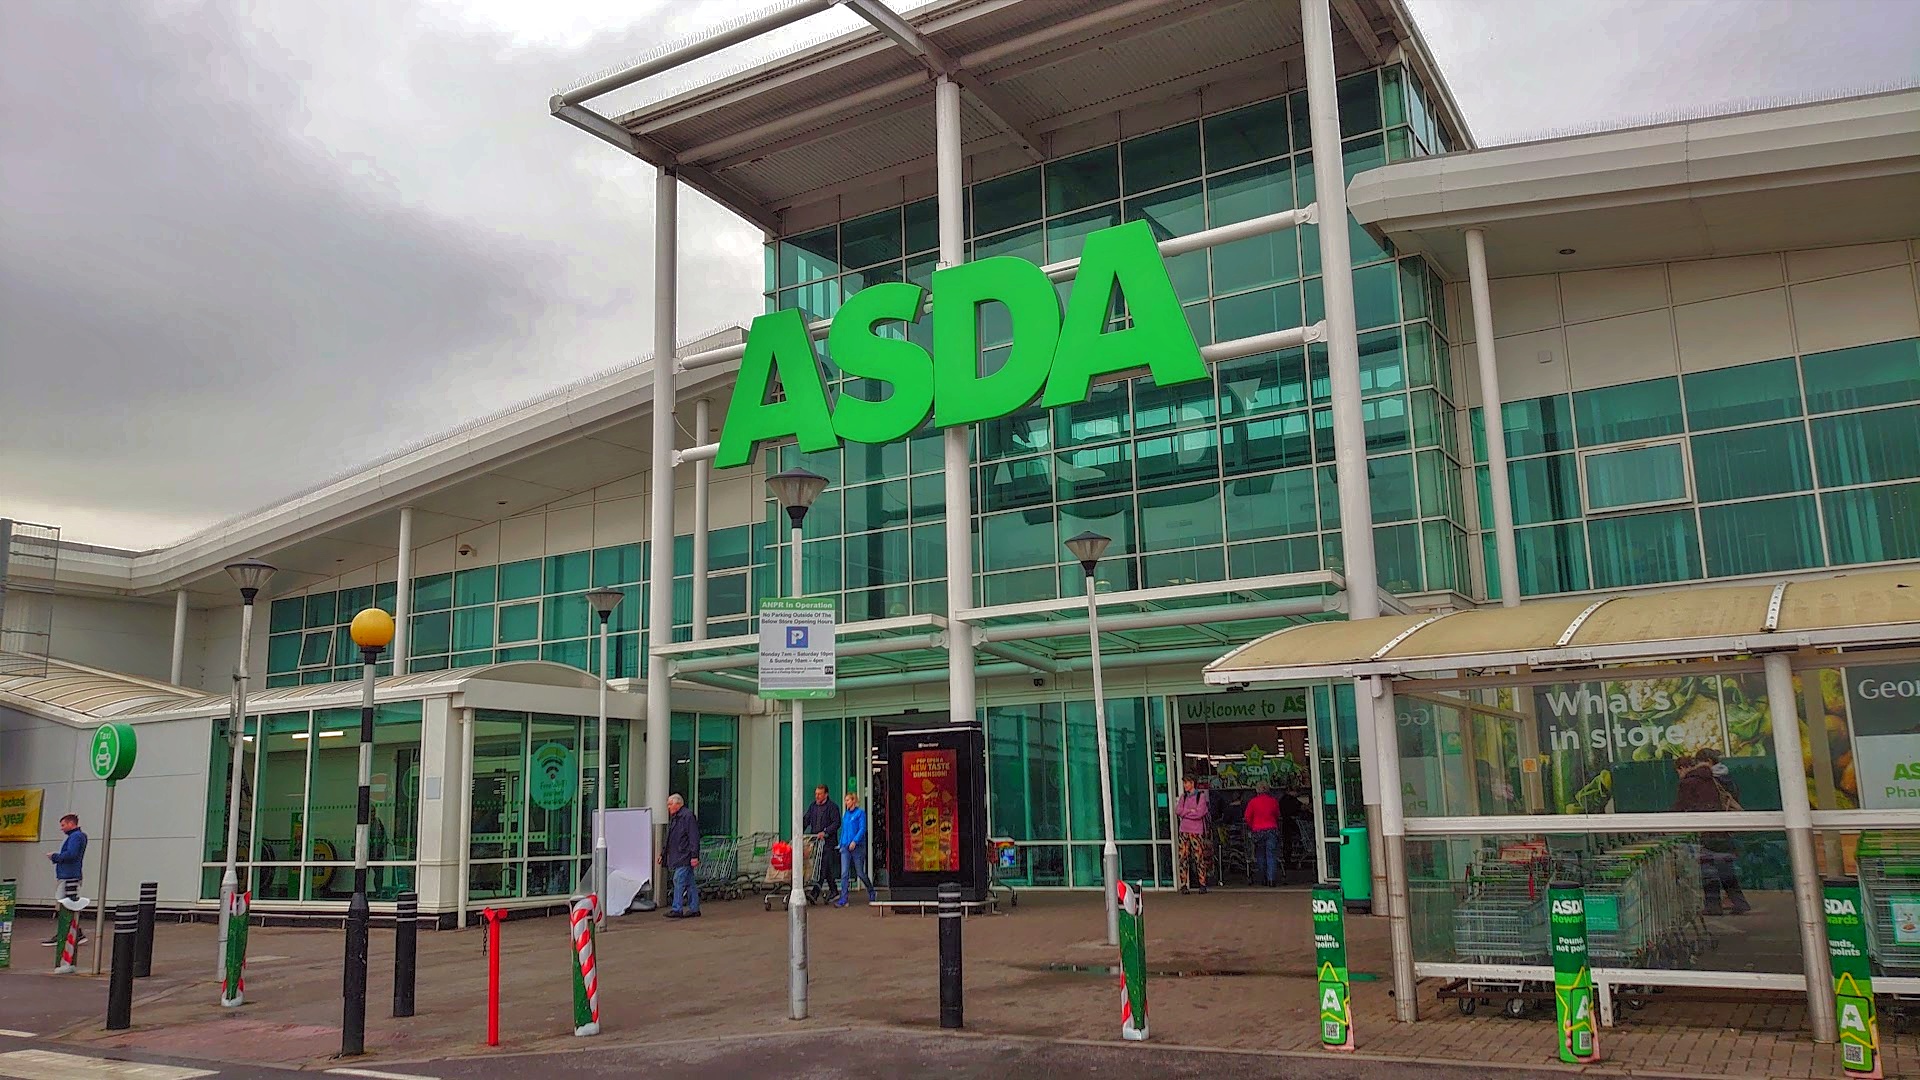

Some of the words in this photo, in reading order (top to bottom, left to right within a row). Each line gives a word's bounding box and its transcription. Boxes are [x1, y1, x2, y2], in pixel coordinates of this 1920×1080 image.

[713, 218, 1211, 469] ASDA
[791, 630, 804, 645] P
[1187, 701, 1256, 719] Welcome
[1261, 700, 1275, 717] to
[1545, 687, 1671, 717] What's
[1550, 725, 1580, 750] in
[911, 763, 927, 772] NEW
[1241, 765, 1269, 776] ASDA
[1885, 786, 1920, 798] Pha
[4, 813, 26, 828] year
